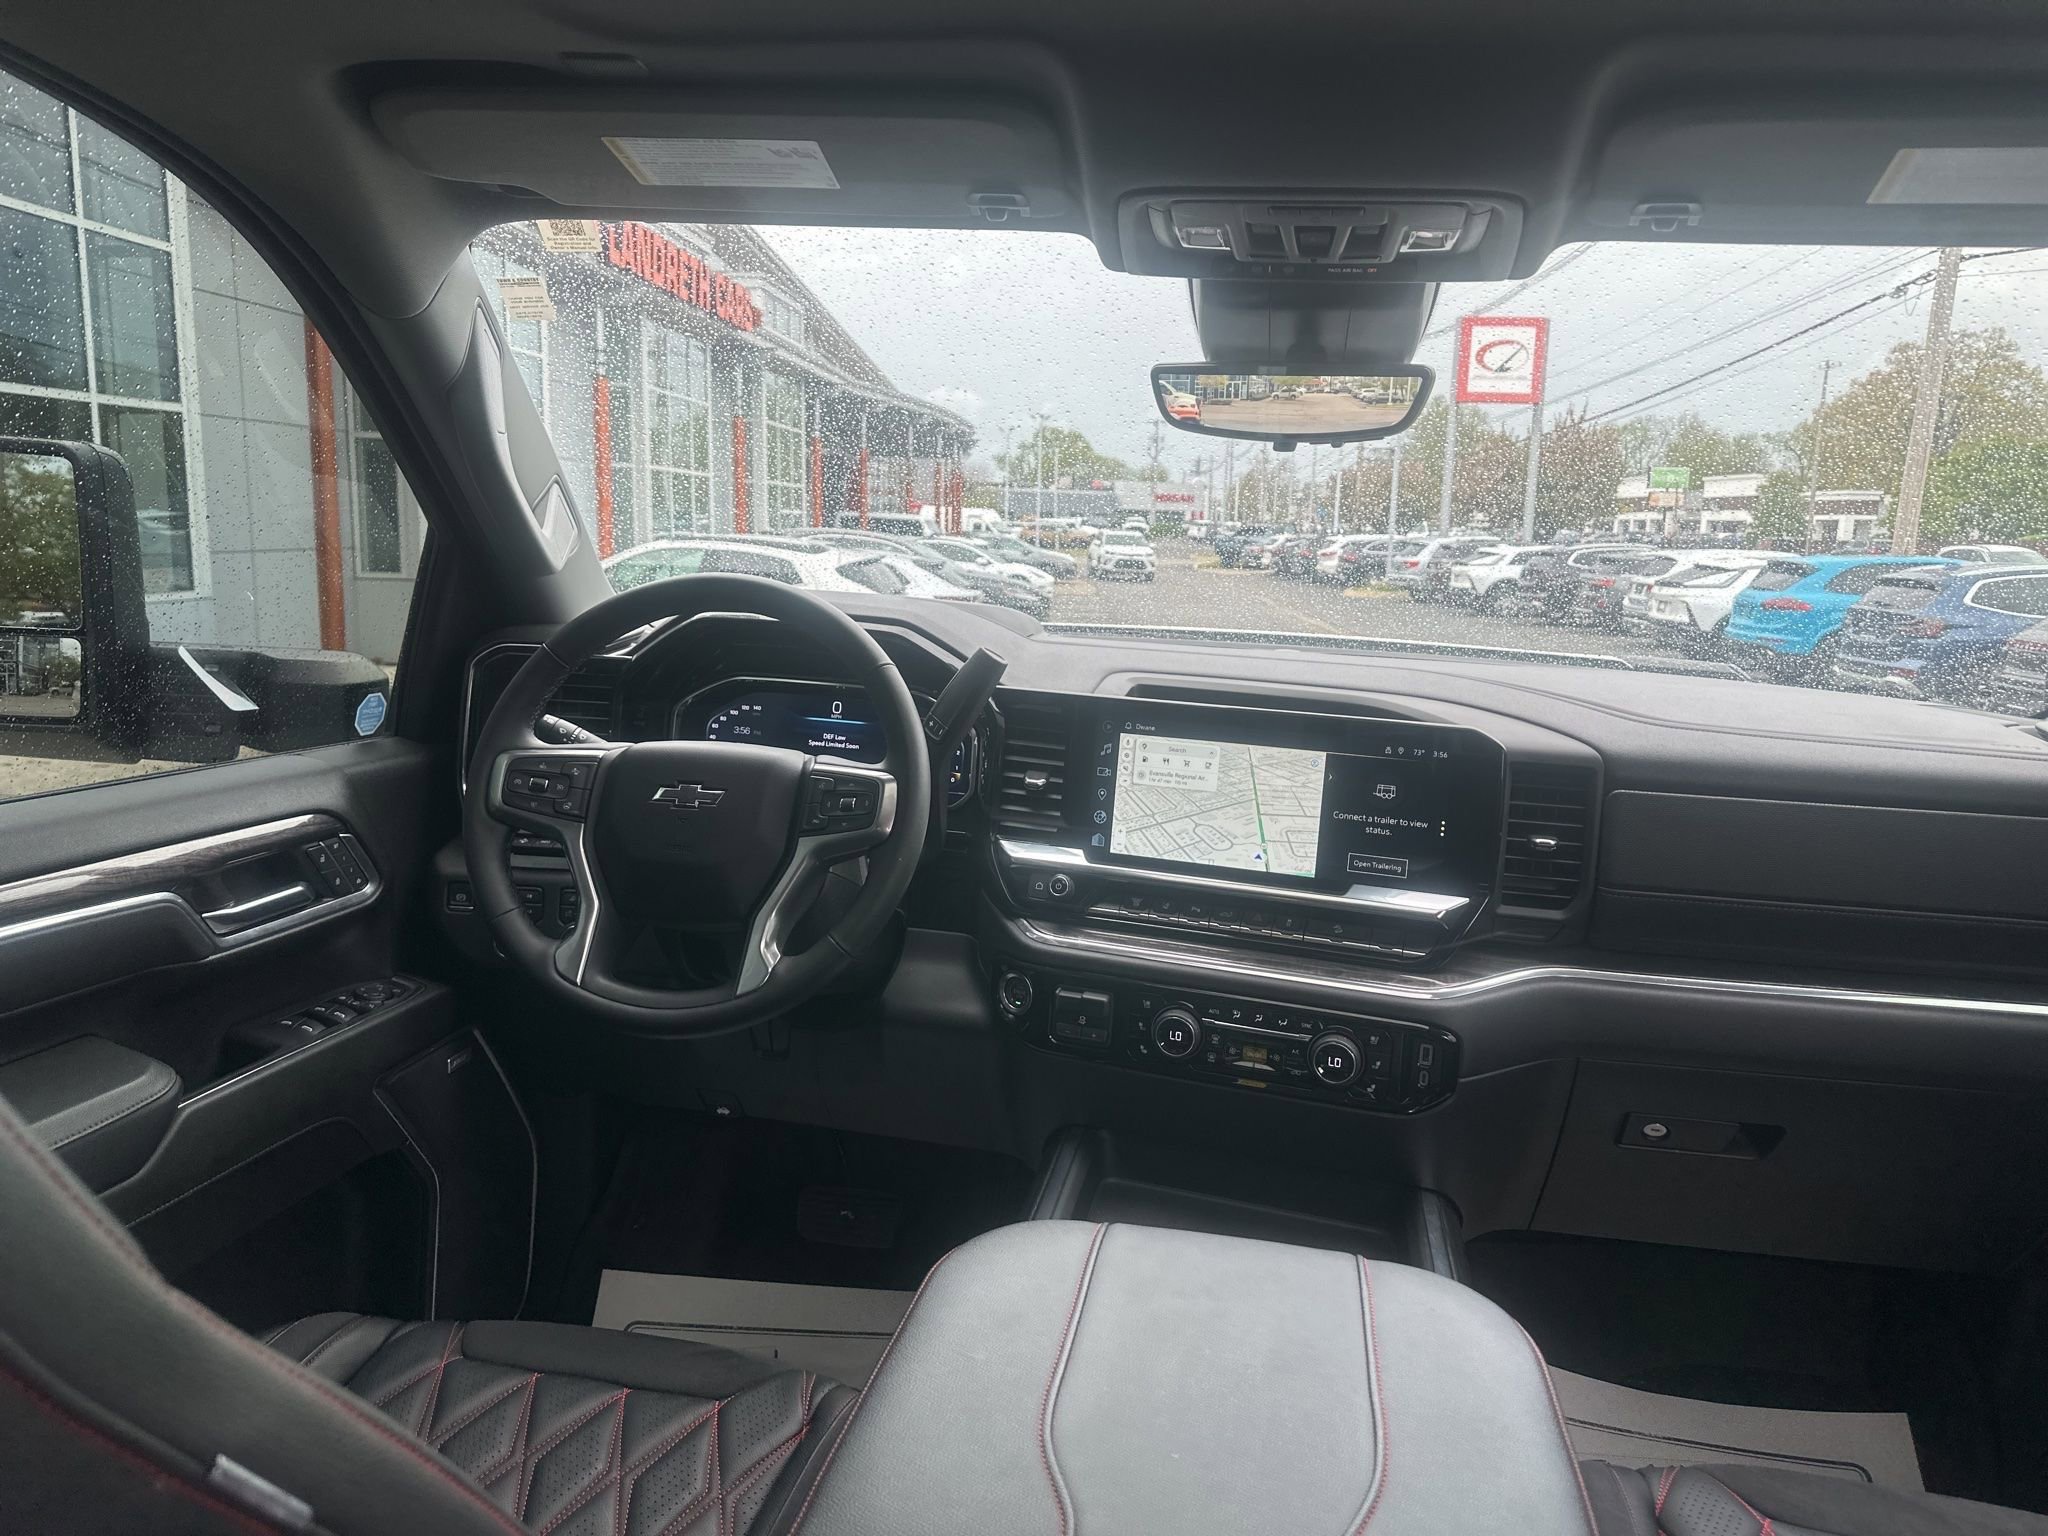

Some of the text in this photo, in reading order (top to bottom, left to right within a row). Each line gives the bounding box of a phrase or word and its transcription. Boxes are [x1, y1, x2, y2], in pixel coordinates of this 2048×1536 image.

[832, 701, 842, 714] 0
[733, 725, 751, 735] 3:56
[823, 732, 834, 740] DEF
[808, 739, 860, 750] Speed Limited Soon
[1432, 750, 1448, 758] 3:56
[1332, 810, 1366, 822] Connect
[1374, 816, 1398, 825] trailer
[1399, 818, 1408, 826] to
[1409, 820, 1429, 828] view
[1365, 826, 1393, 836] status.
[1353, 859, 1402, 873] Open Trailering
[1169, 1030, 1182, 1041] LO
[1327, 1056, 1342, 1068] LO
